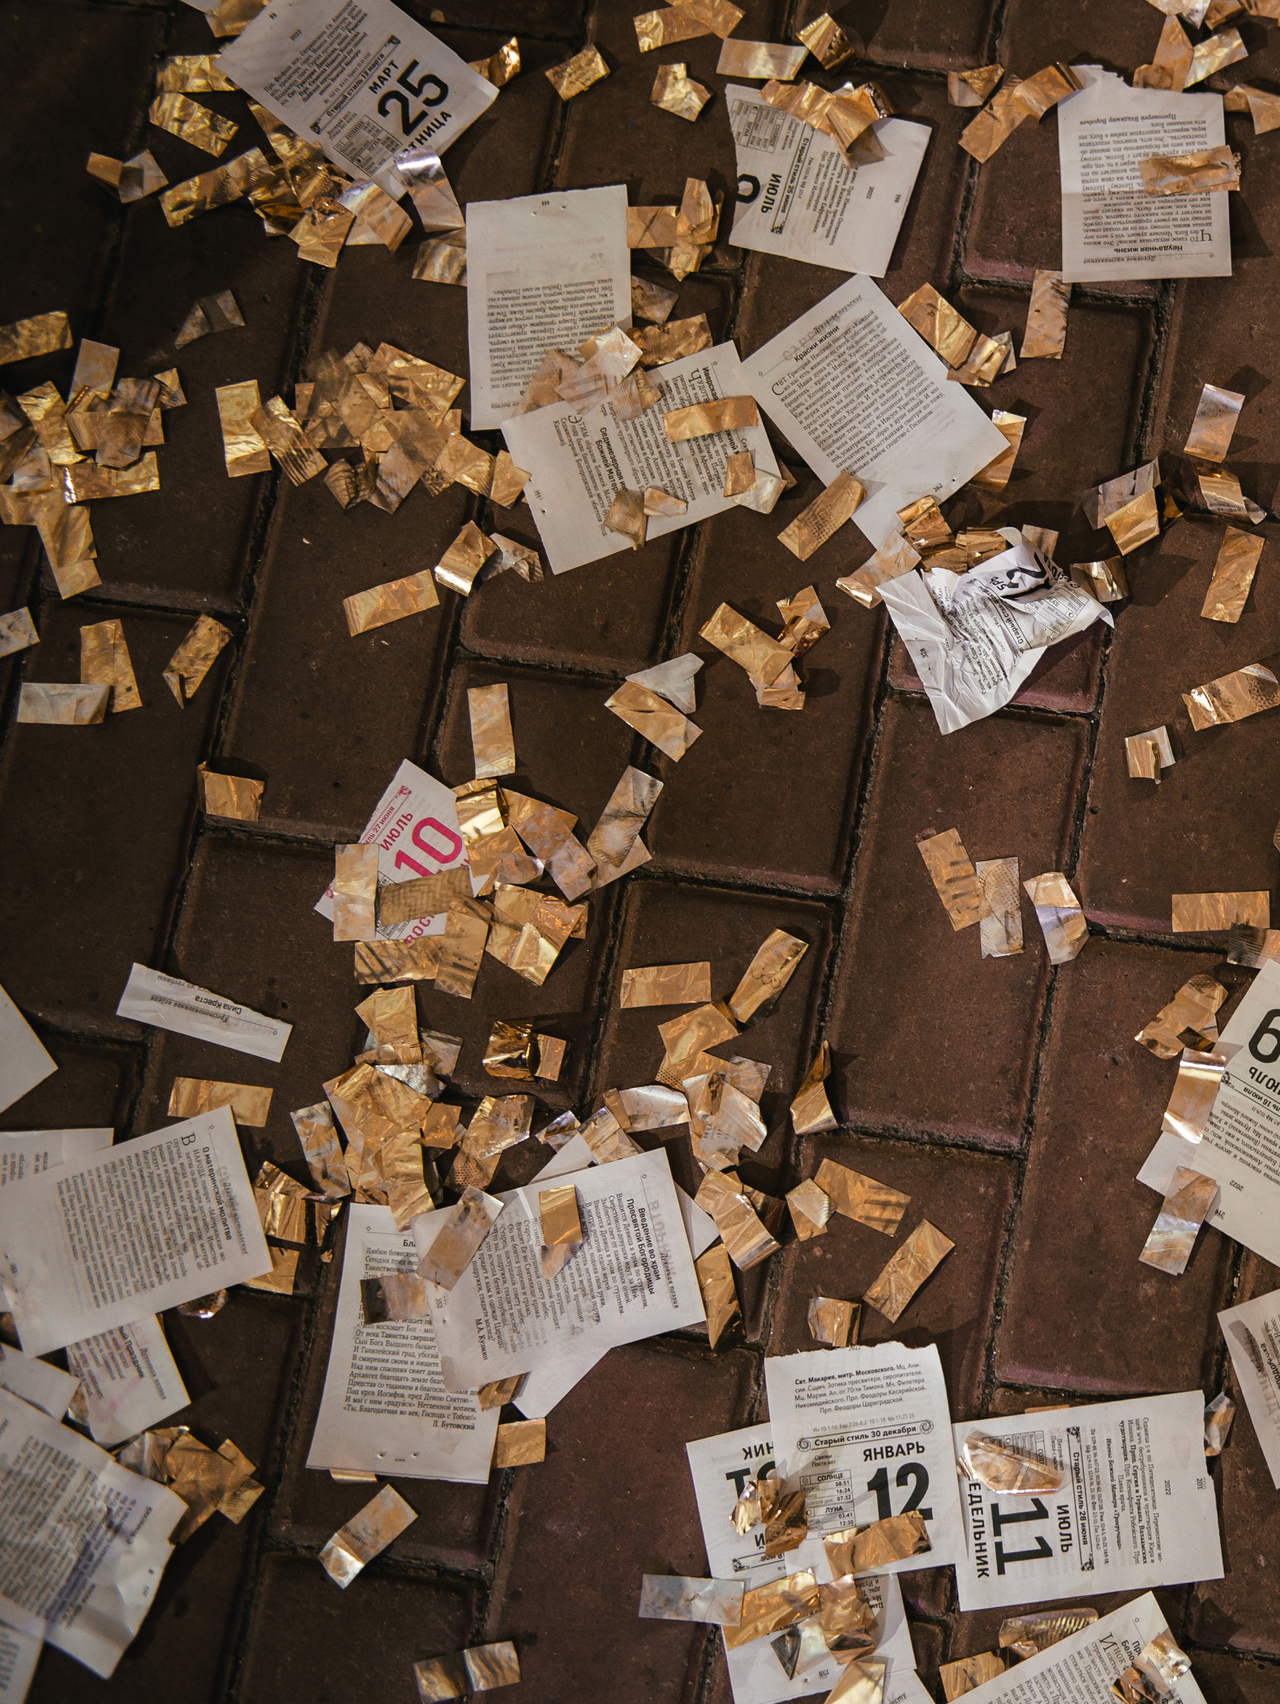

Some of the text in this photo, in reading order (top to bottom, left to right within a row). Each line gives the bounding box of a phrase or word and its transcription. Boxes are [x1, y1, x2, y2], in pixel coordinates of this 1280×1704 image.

[325, 93, 349, 117] Старый
[346, 78, 364, 96] стиль
[367, 52, 385, 72] марта
[368, 59, 399, 94] МАРТ
[377, 58, 449, 136] 25
[1078, 117, 1106, 125] Воробьев
[1139, 112, 1176, 120] Протоиерей
[402, 110, 452, 152] ТНИЦА
[795, 137, 809, 164] Старый
[788, 163, 799, 184] стиль
[759, 173, 782, 213] ИЮЛЬ
[780, 194, 789, 214] июня
[865, 186, 874, 199] 2022
[1139, 243, 1182, 251] Неудачная
[793, 325, 840, 362] Краски жизни
[701, 366, 720, 402] Иверская
[594, 439, 611, 469] Божией
[598, 426, 623, 481] Седмиезерная
[933, 482, 943, 492] 262
[379, 805, 395, 825] июня
[379, 812, 414, 851] ИЮЛЬ
[394, 816, 464, 877] 10
[149, 994, 229, 1023] Крестопоклонная неделя
[193, 994, 242, 1015] Сила Креста
[1242, 1085, 1263, 1101] июля
[203, 1153, 224, 1206] материнской
[217, 1206, 232, 1241] молитве
[1228, 1178, 1244, 1191] 2022
[625, 1198, 655, 1295] Пресвятой Богородицы
[637, 1207, 652, 1248] Введение
[650, 1259, 661, 1281] храм
[434, 1298, 443, 1309] 352
[124, 1340, 144, 1379] Праздник
[807, 1375, 835, 1383] Макария,
[855, 1366, 894, 1376] Московского.
[814, 1435, 845, 1447] Старый
[846, 1433, 870, 1442] стиль
[882, 1425, 917, 1437] декабря
[863, 1441, 925, 1462] ЯНВАРЬ
[816, 1472, 843, 1482] СОЛНЦЕ
[1072, 1451, 1082, 1484] Старый
[836, 1494, 852, 1502] 07:32
[866, 1461, 934, 1525] 12
[1075, 1484, 1083, 1510] стиль
[1163, 1479, 1171, 1496] 2022
[825, 1505, 844, 1513] ЛУНА
[967, 1482, 989, 1579] ЕДЕЛЬНИК
[989, 1497, 1053, 1576] 11
[1055, 1504, 1072, 1553] ИЮЛЬ
[1079, 1522, 1087, 1545] июня
